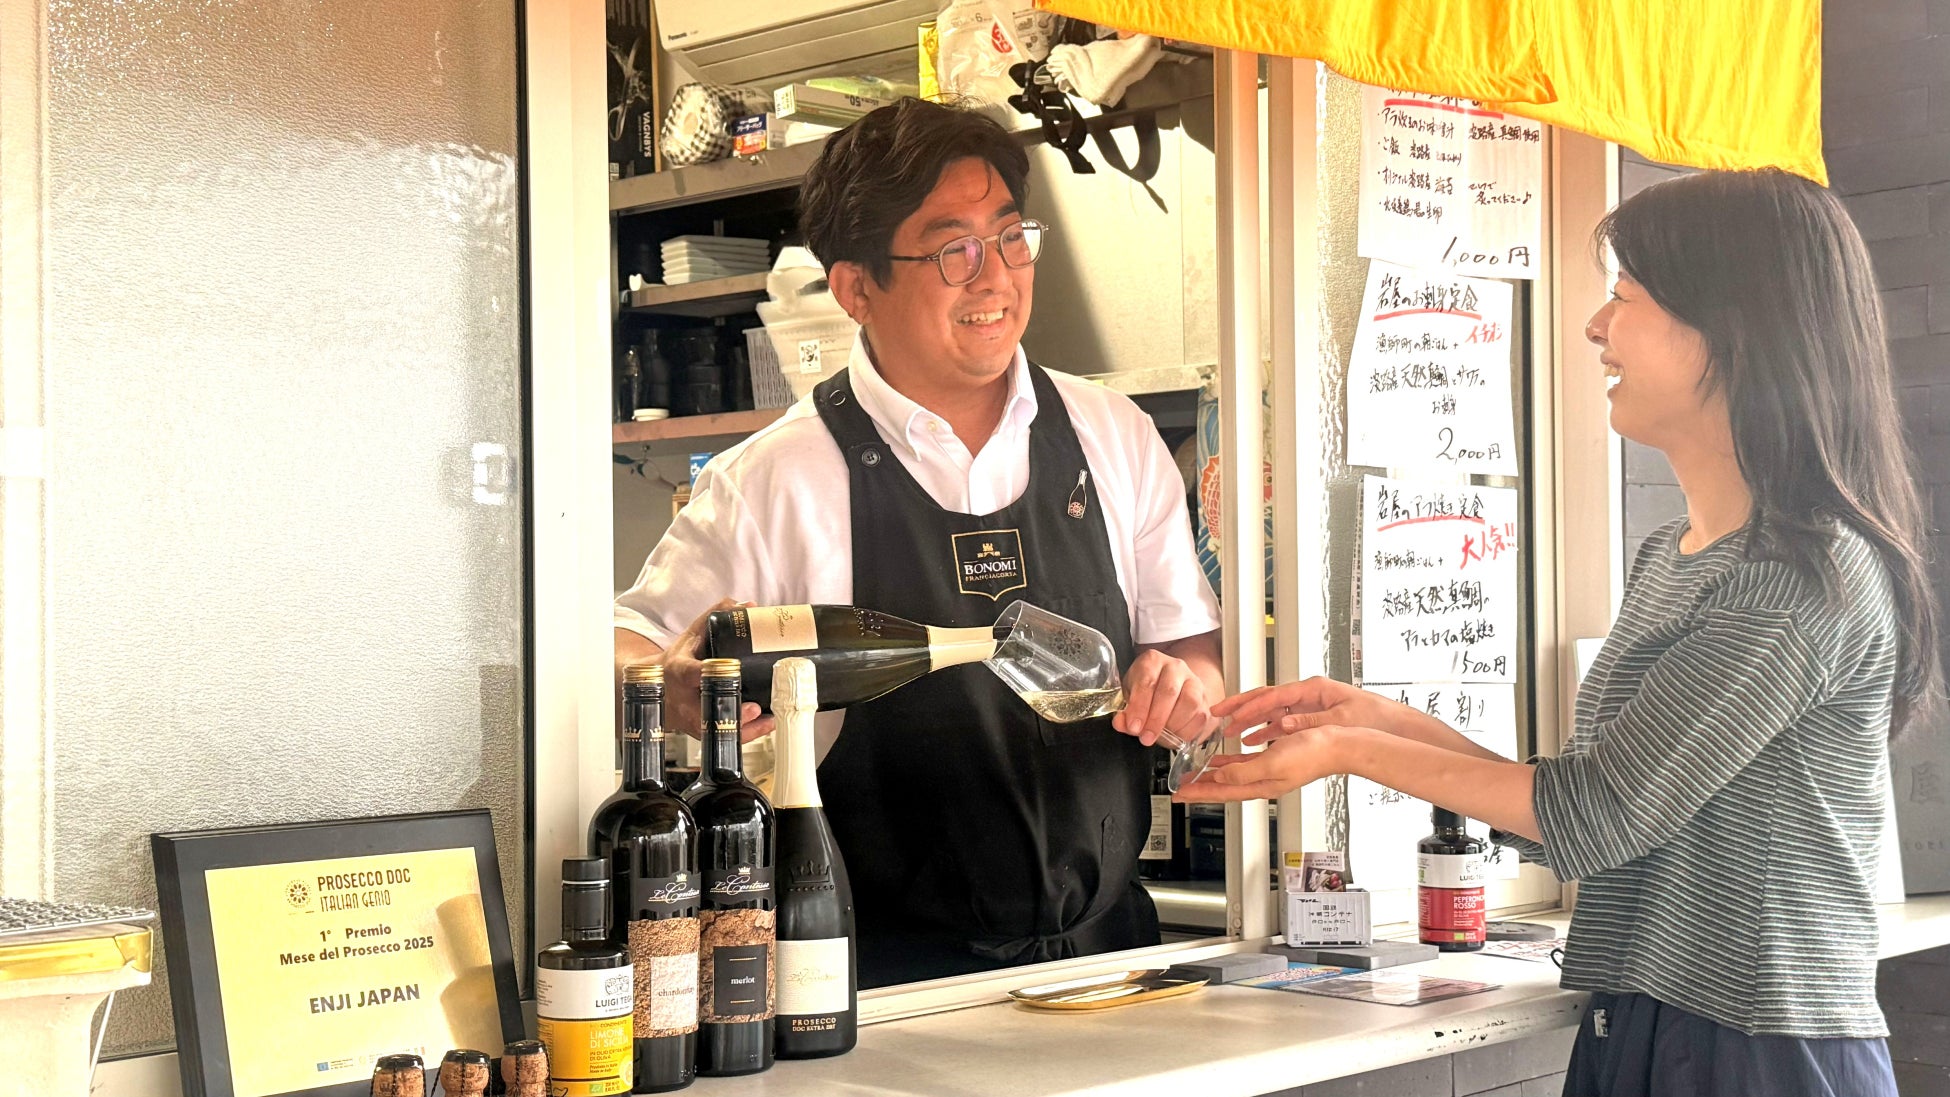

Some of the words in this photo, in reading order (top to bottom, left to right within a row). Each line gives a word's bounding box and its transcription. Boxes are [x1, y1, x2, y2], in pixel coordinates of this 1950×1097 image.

[643, 112, 652, 158] VAGNBYS
[1442, 236, 1529, 267] 1,000円
[1436, 426, 1501, 465] 2,000円
[964, 560, 1016, 575] BONOMI
[318, 871, 383, 892] PROSECCO
[386, 868, 410, 884] DOC
[320, 892, 359, 912] ITALIAN
[362, 890, 391, 908] GENIO
[345, 924, 392, 939] Premio
[280, 953, 315, 966] Mese
[319, 947, 340, 960] del
[343, 942, 400, 958] Prosecco
[404, 936, 434, 950] 2025
[730, 976, 755, 984] merlot
[310, 992, 351, 1014] ENJI
[356, 983, 420, 1010] JAPAN
[596, 998, 618, 1007] LUIGI
[792, 1017, 836, 1026] PROSECCO
[590, 1027, 624, 1039] LIMONE
[590, 1040, 600, 1048] DI
